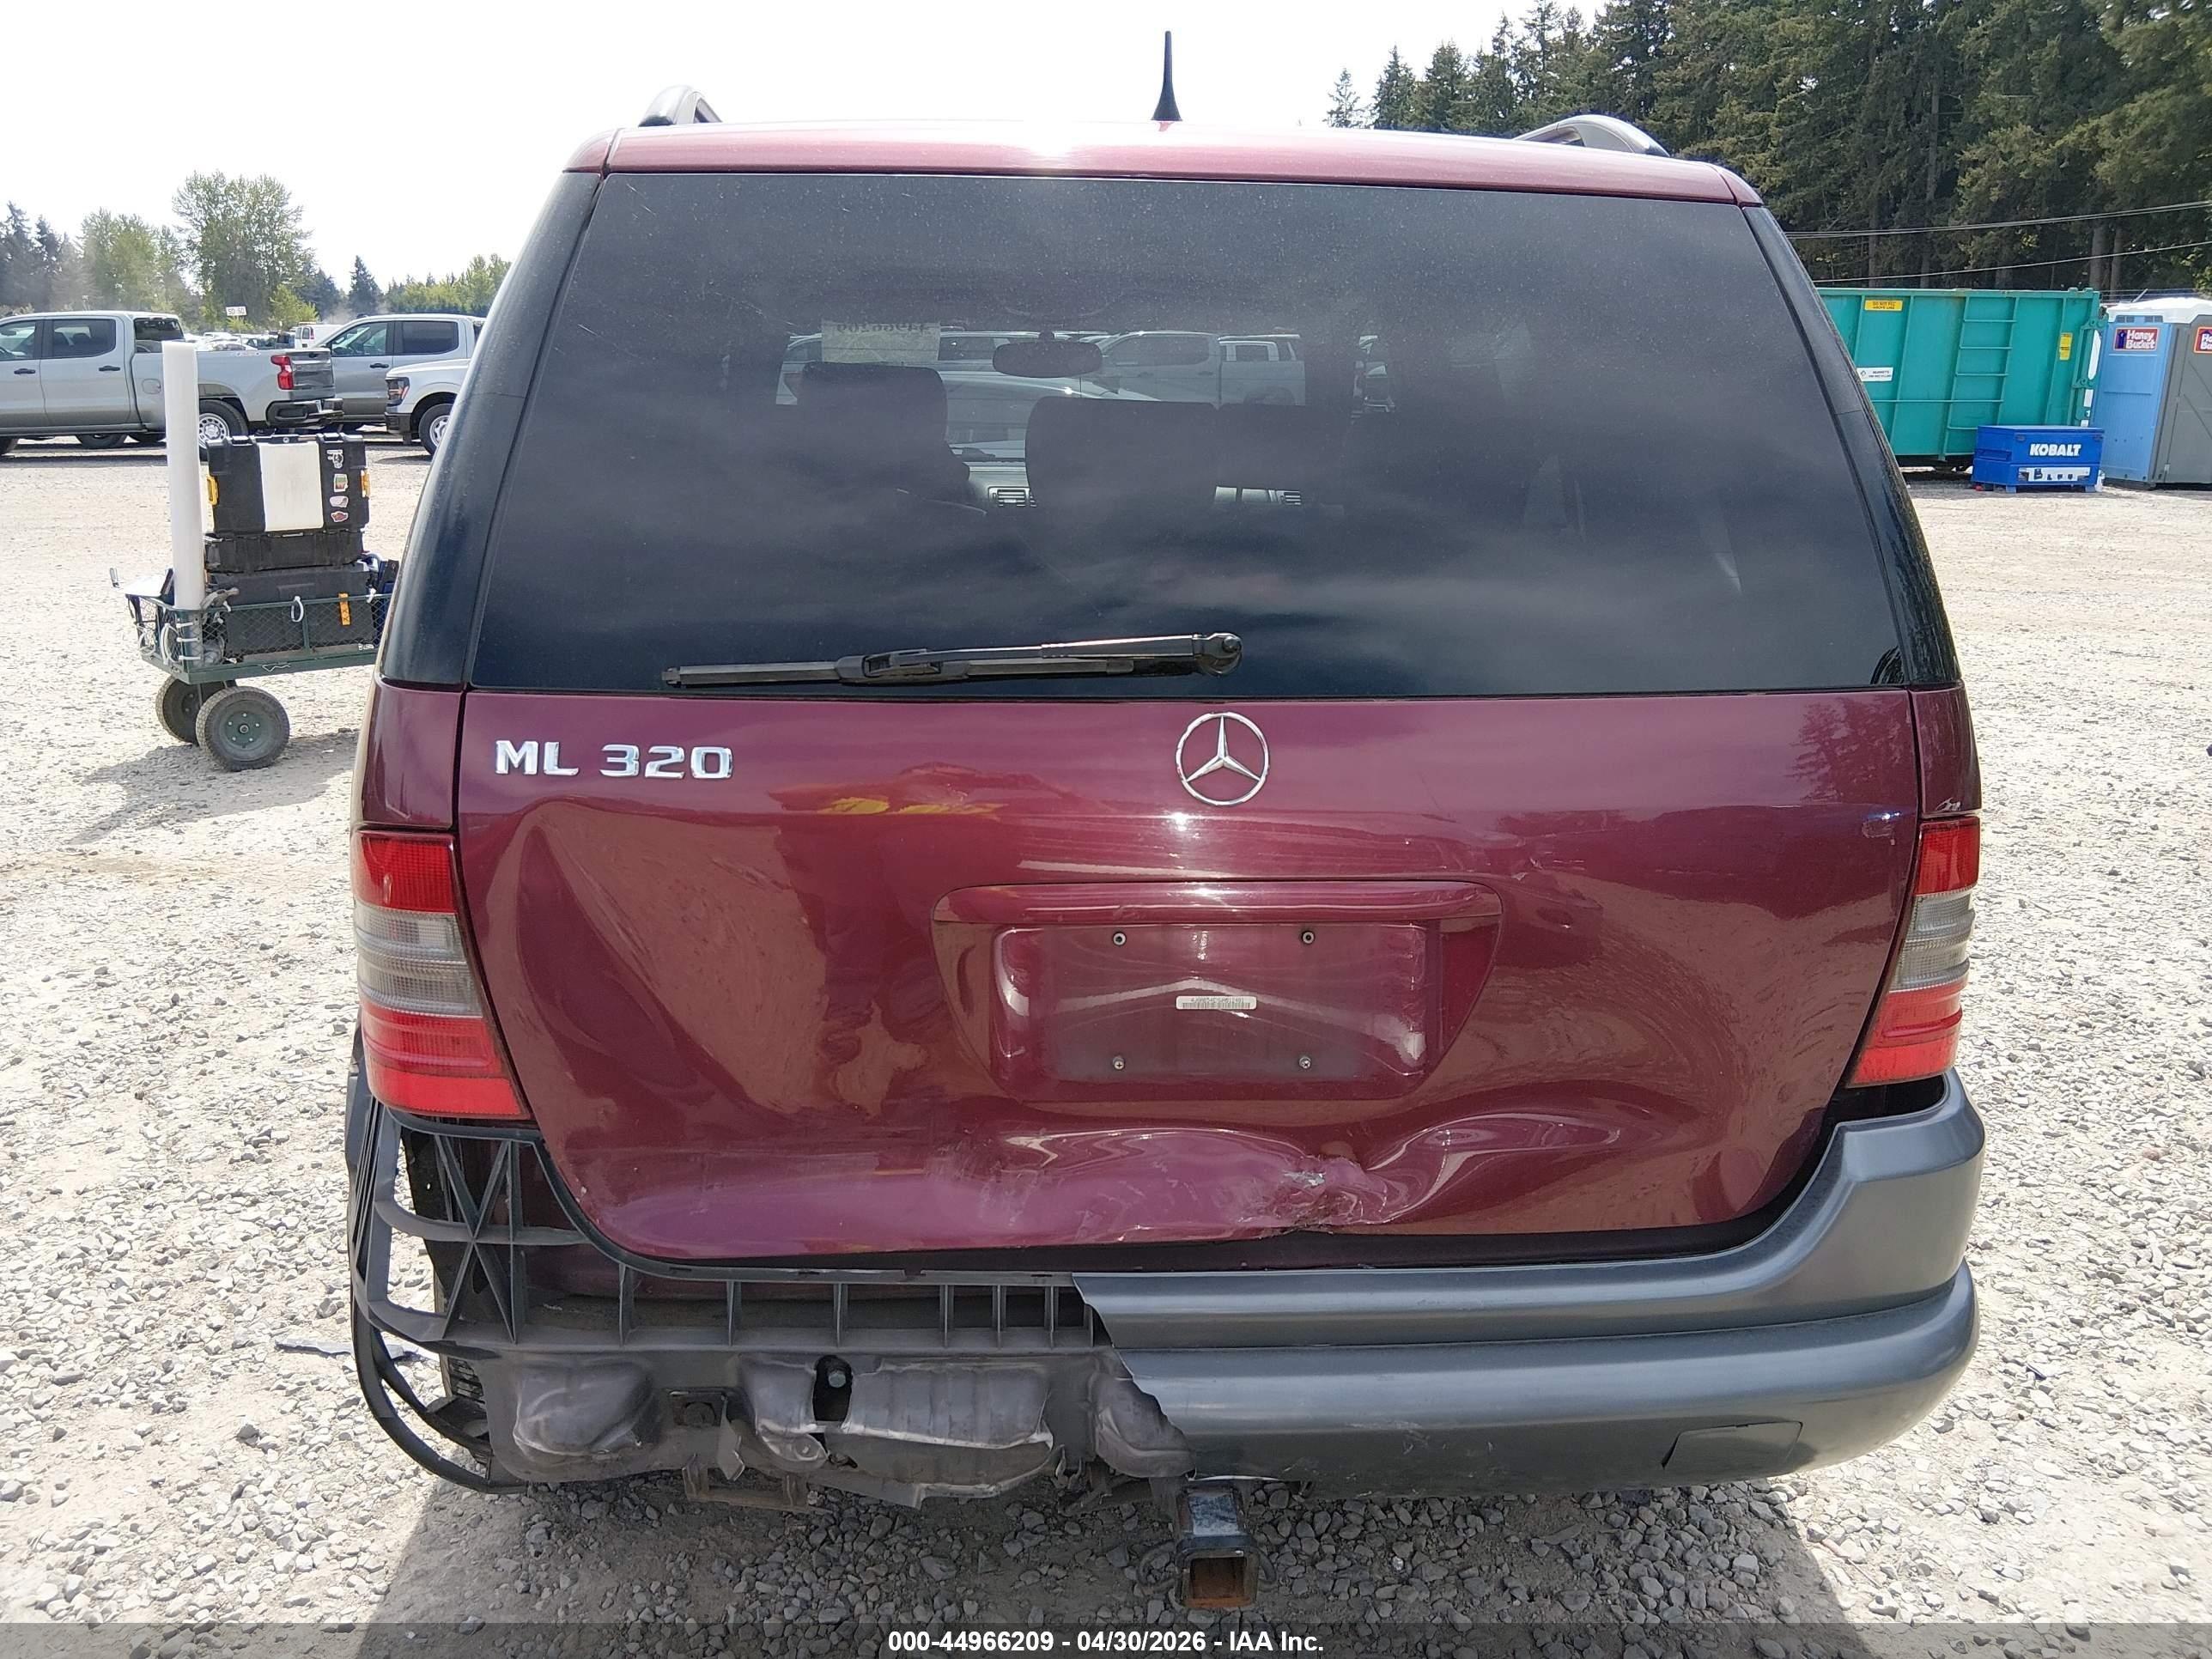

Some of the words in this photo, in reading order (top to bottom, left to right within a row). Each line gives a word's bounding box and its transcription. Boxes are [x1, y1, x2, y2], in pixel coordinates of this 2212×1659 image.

[2127, 330, 2154, 341] Honey
[2125, 339, 2155, 349] Bucket
[2029, 443, 2081, 456] KOBALT
[495, 740, 579, 775] ML
[599, 744, 733, 779] 320
